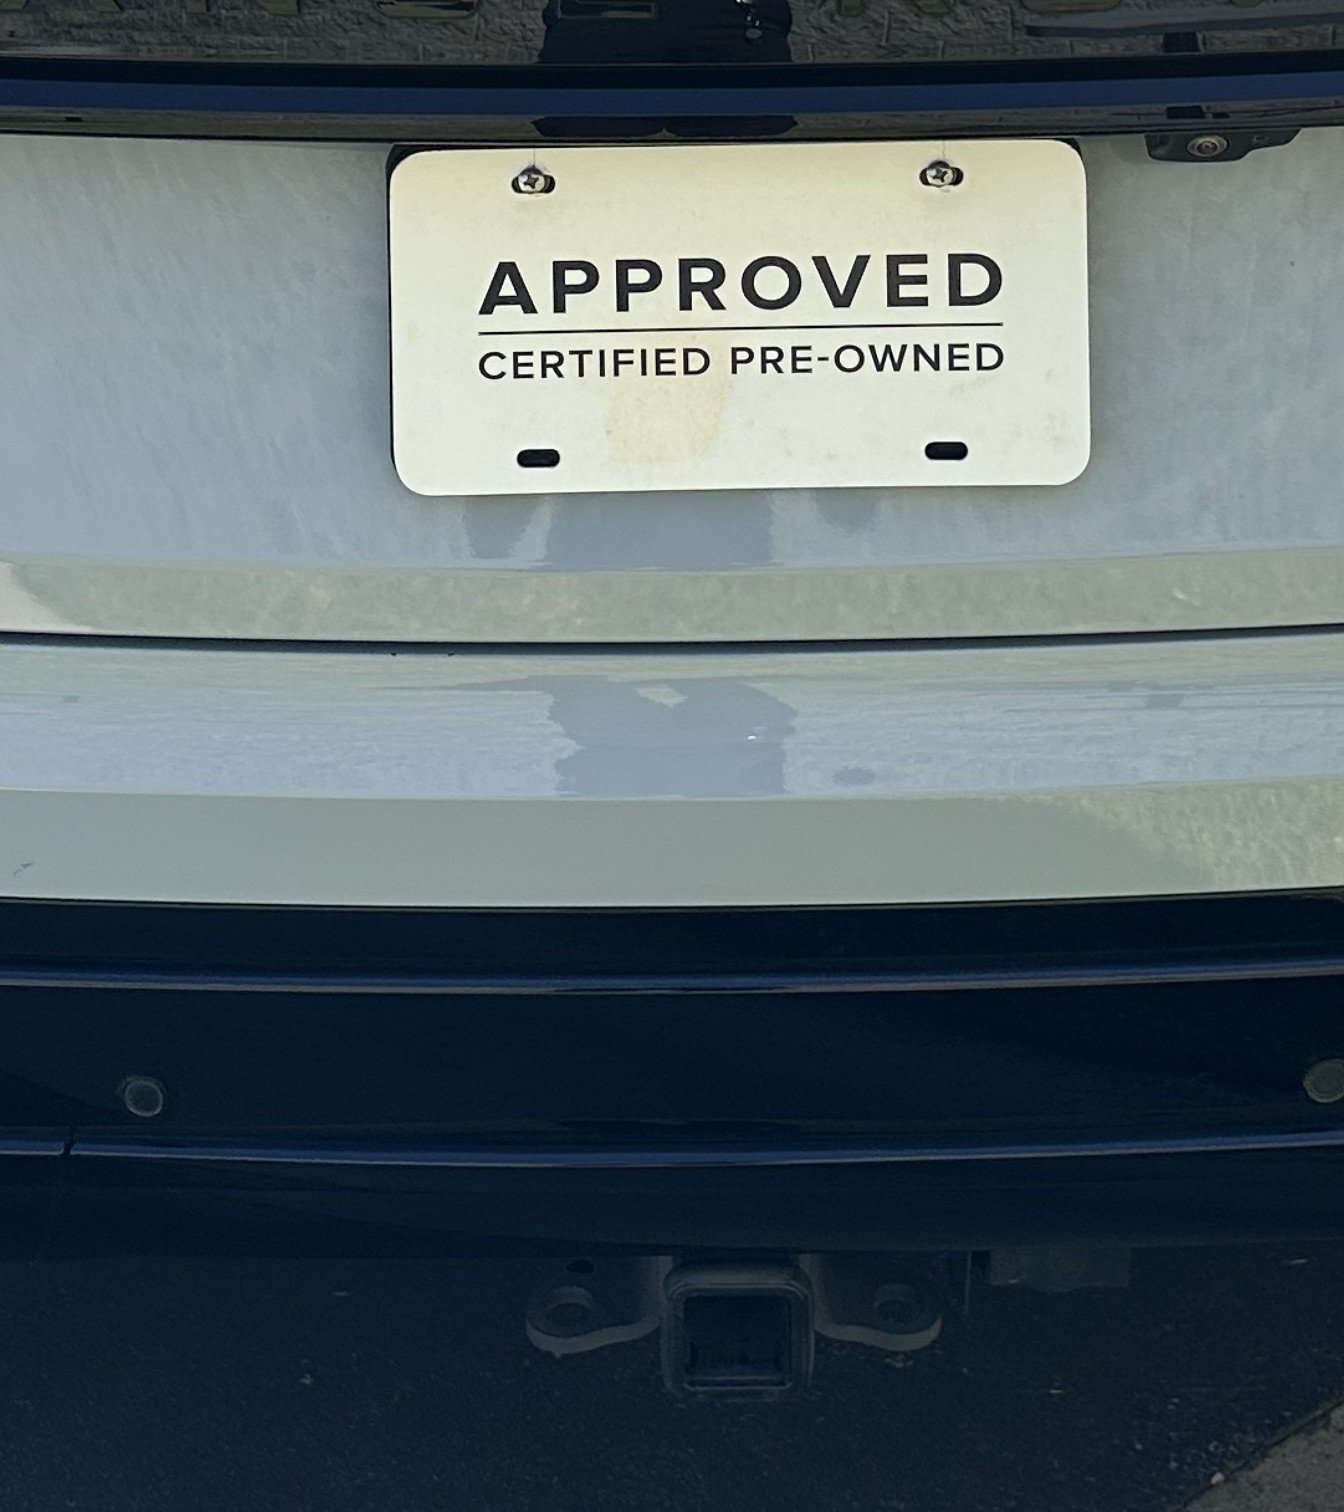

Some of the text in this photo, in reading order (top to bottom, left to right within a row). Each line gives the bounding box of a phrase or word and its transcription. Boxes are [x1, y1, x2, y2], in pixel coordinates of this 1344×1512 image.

[479, 254, 1003, 316] APPROVED
[479, 344, 1004, 379] CERTIFIED PRE-OWNED
